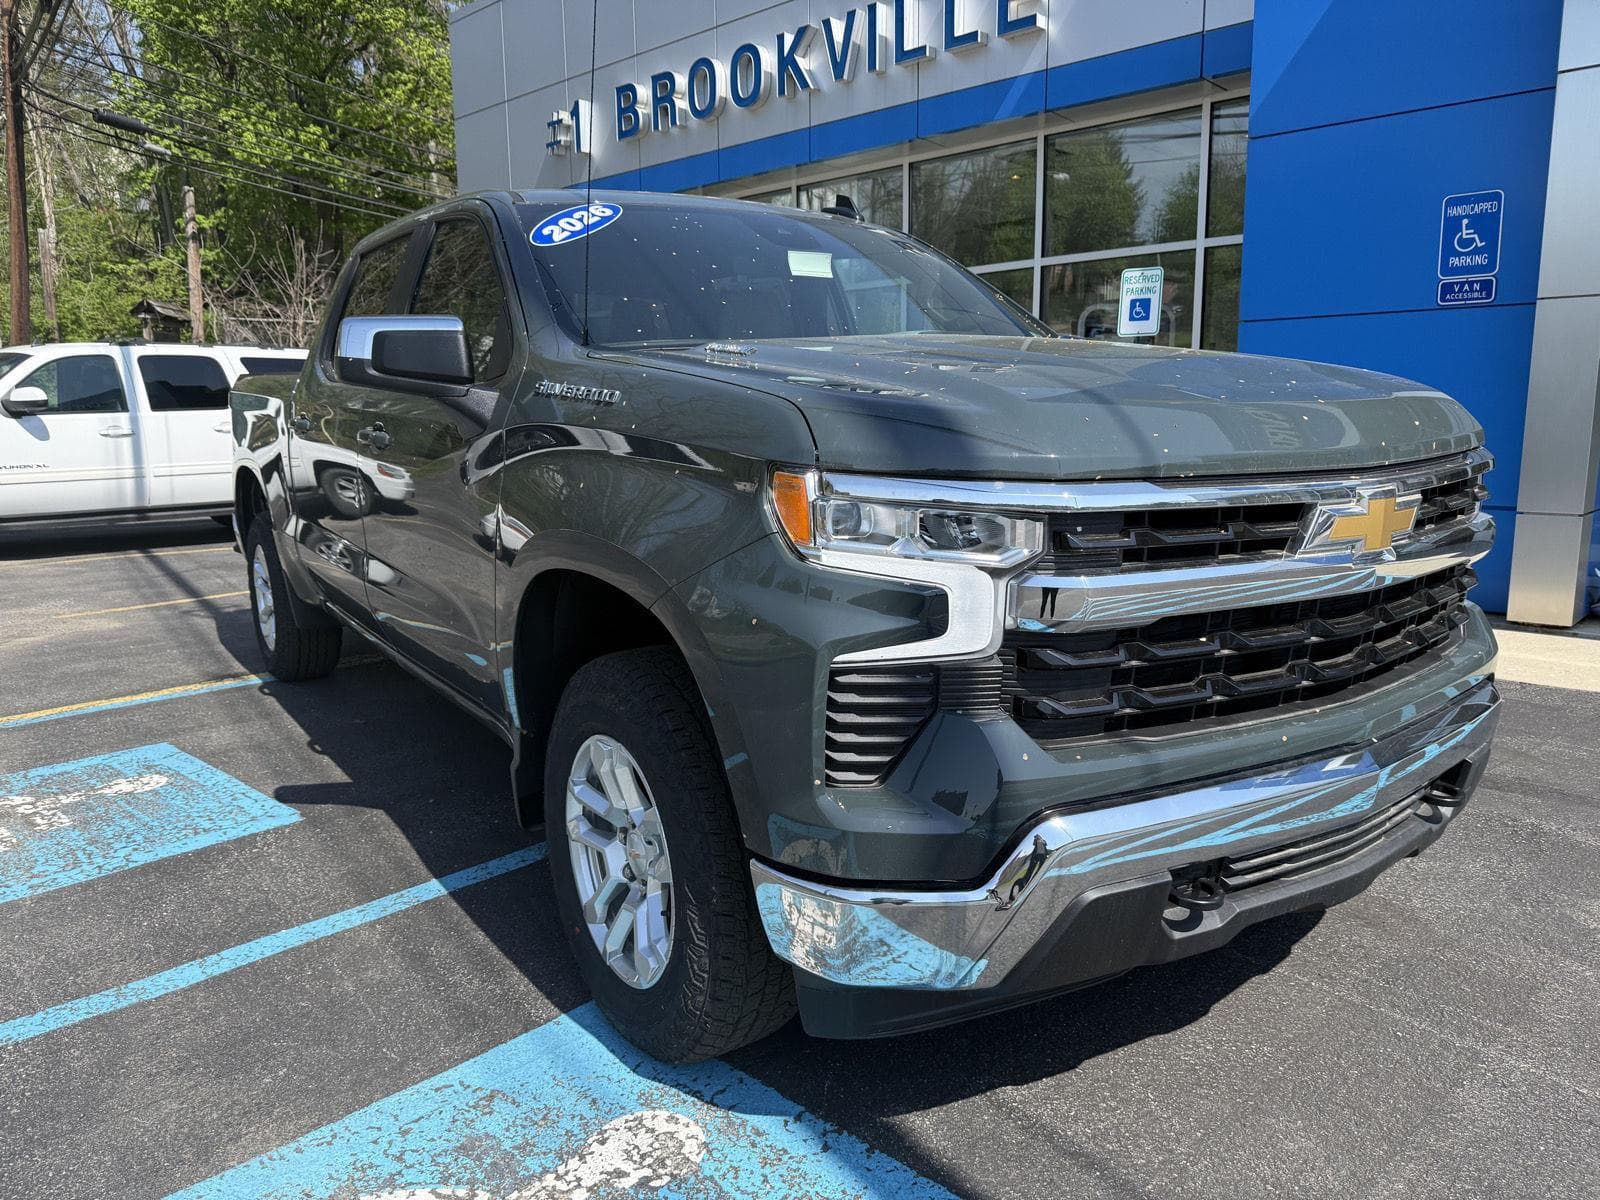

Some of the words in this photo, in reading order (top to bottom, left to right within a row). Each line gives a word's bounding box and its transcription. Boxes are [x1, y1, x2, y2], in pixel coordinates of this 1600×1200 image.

[545, 99, 590, 157] #1
[1447, 201, 1498, 217] HANDICAPPED
[541, 204, 615, 243] 2026
[1449, 254, 1488, 267] PARKING
[1124, 274, 1160, 285] RESERVED
[1126, 285, 1157, 296] PARKING
[1454, 282, 1481, 292] VAN
[1445, 291, 1487, 300] ACCESSIBLE
[535, 380, 621, 403] SILVERADO
